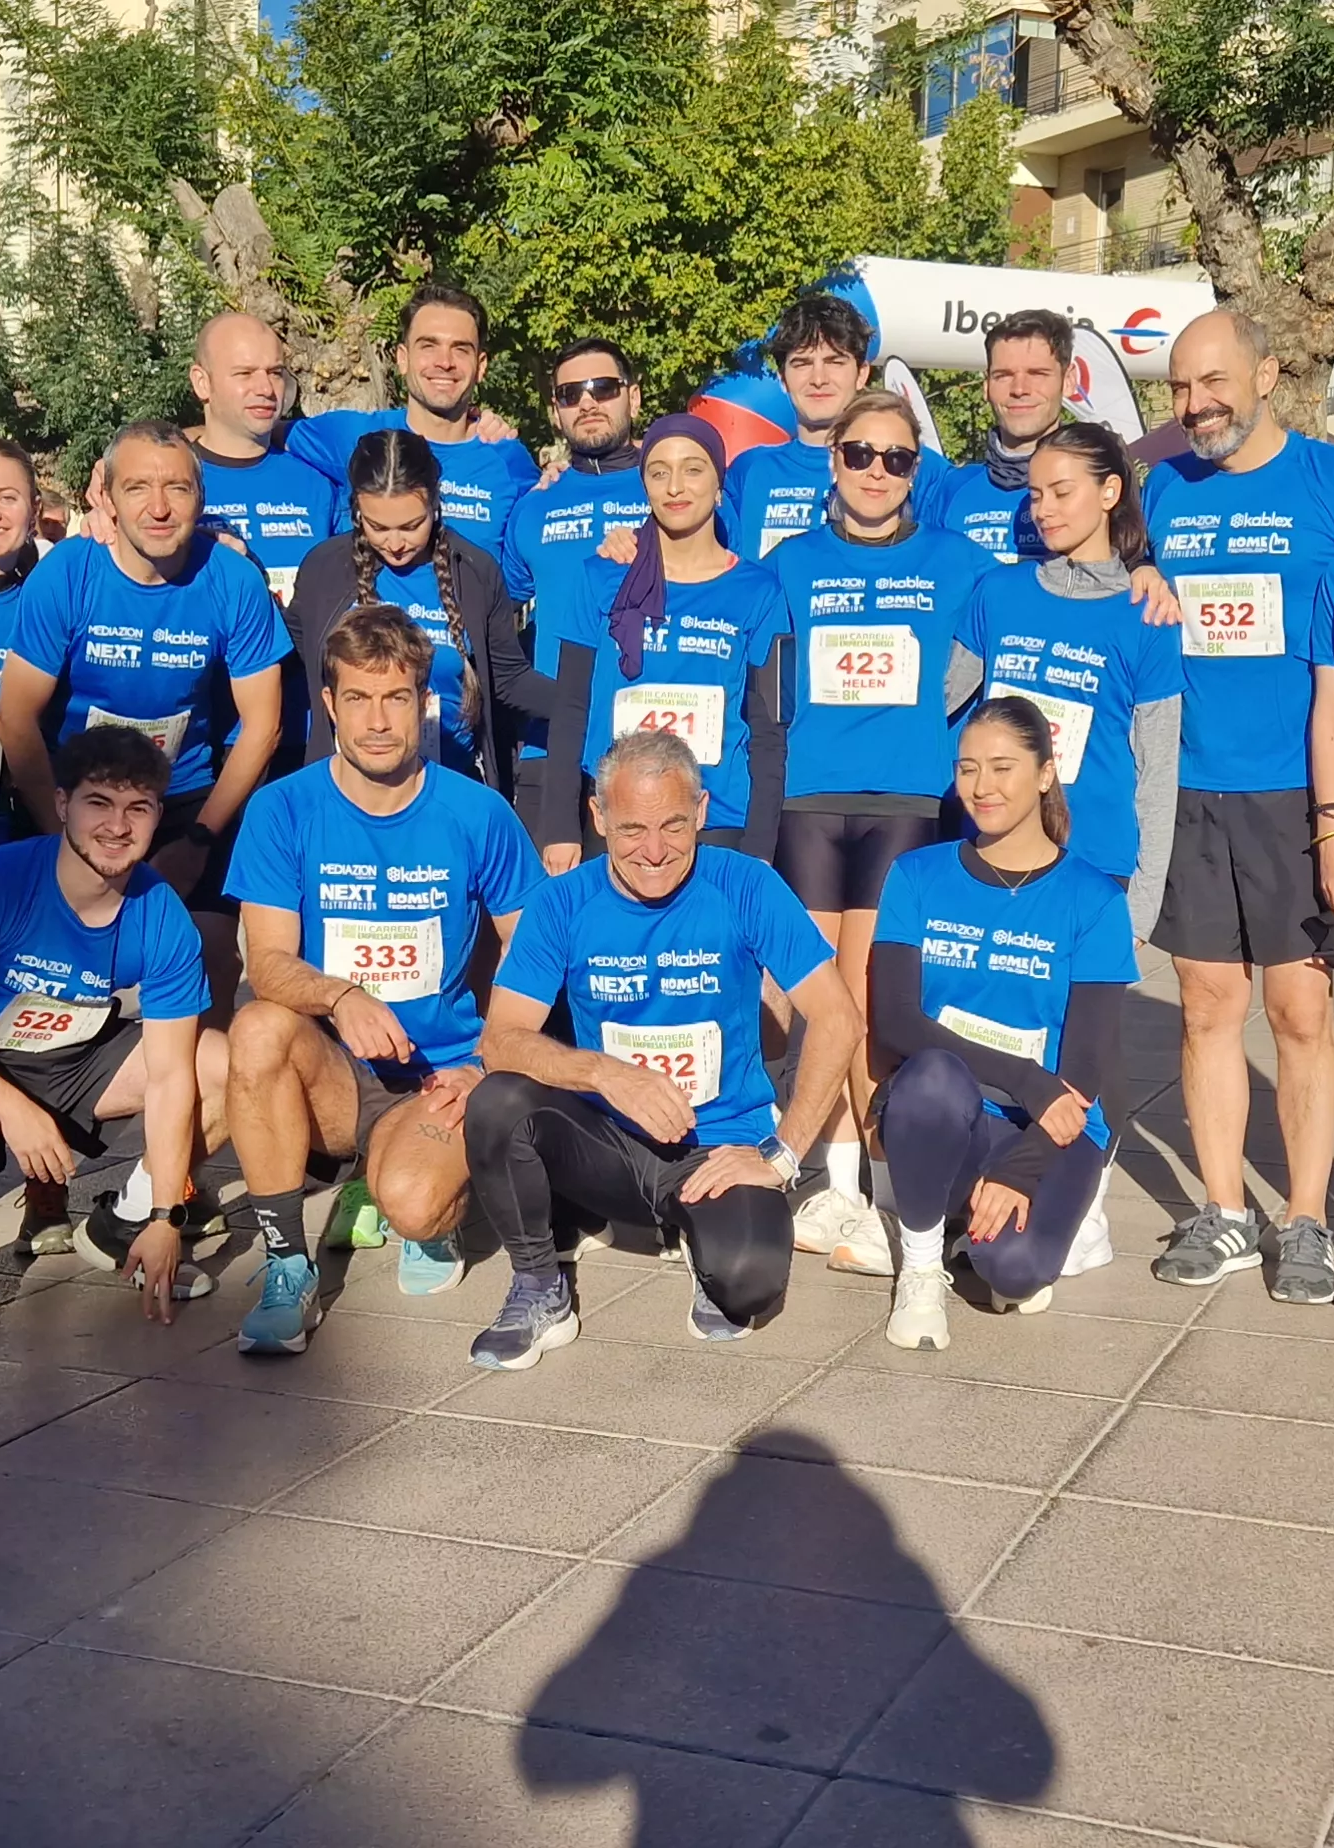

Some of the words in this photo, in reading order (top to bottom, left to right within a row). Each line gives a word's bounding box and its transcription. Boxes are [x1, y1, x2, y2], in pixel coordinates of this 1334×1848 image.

[452, 481, 492, 500] kablex
[766, 503, 813, 519] NEXT
[1244, 511, 1293, 528] kablex
[543, 518, 593, 536] NEXT
[1164, 533, 1216, 550] NEXT
[1228, 536, 1268, 548] HOME
[812, 578, 866, 589] MEDIAZION
[889, 575, 935, 590] kablex
[810, 592, 865, 609] NEXT
[876, 595, 916, 606] HOME
[1199, 602, 1255, 627] 532
[88, 625, 144, 639] MEDIAZION
[694, 616, 739, 636] kablex
[165, 628, 209, 646] kablex
[679, 636, 717, 649] HOME
[1208, 630, 1247, 640] DAVID
[86, 641, 142, 660] NEXT
[1063, 643, 1107, 668] kablex
[1206, 643, 1225, 653] 8K
[836, 652, 894, 675] 423
[994, 654, 1040, 672] NEXT
[1046, 666, 1082, 682] HOME
[842, 679, 886, 688] HELEN
[842, 690, 861, 701] 8K
[639, 710, 695, 735] 421
[320, 863, 377, 876] MEDIAZION
[400, 865, 450, 883] kablex
[320, 883, 377, 901] NEXT
[388, 892, 430, 904] HOME
[927, 919, 984, 938] MEDIAZION
[922, 937, 979, 960] NEXT
[1007, 931, 1055, 953] kablex
[14, 953, 72, 975] MEDIAZION
[354, 945, 417, 968] 333
[588, 955, 647, 968] MEDIAZION
[672, 948, 720, 967] kablex
[989, 953, 1029, 969] HOME
[7, 968, 67, 997] NEXT
[350, 970, 420, 982] ROBERTO
[589, 975, 648, 993] NEXT
[661, 977, 699, 989] HOME
[13, 1010, 73, 1032] 528
[12, 1031, 53, 1041] DIEGO
